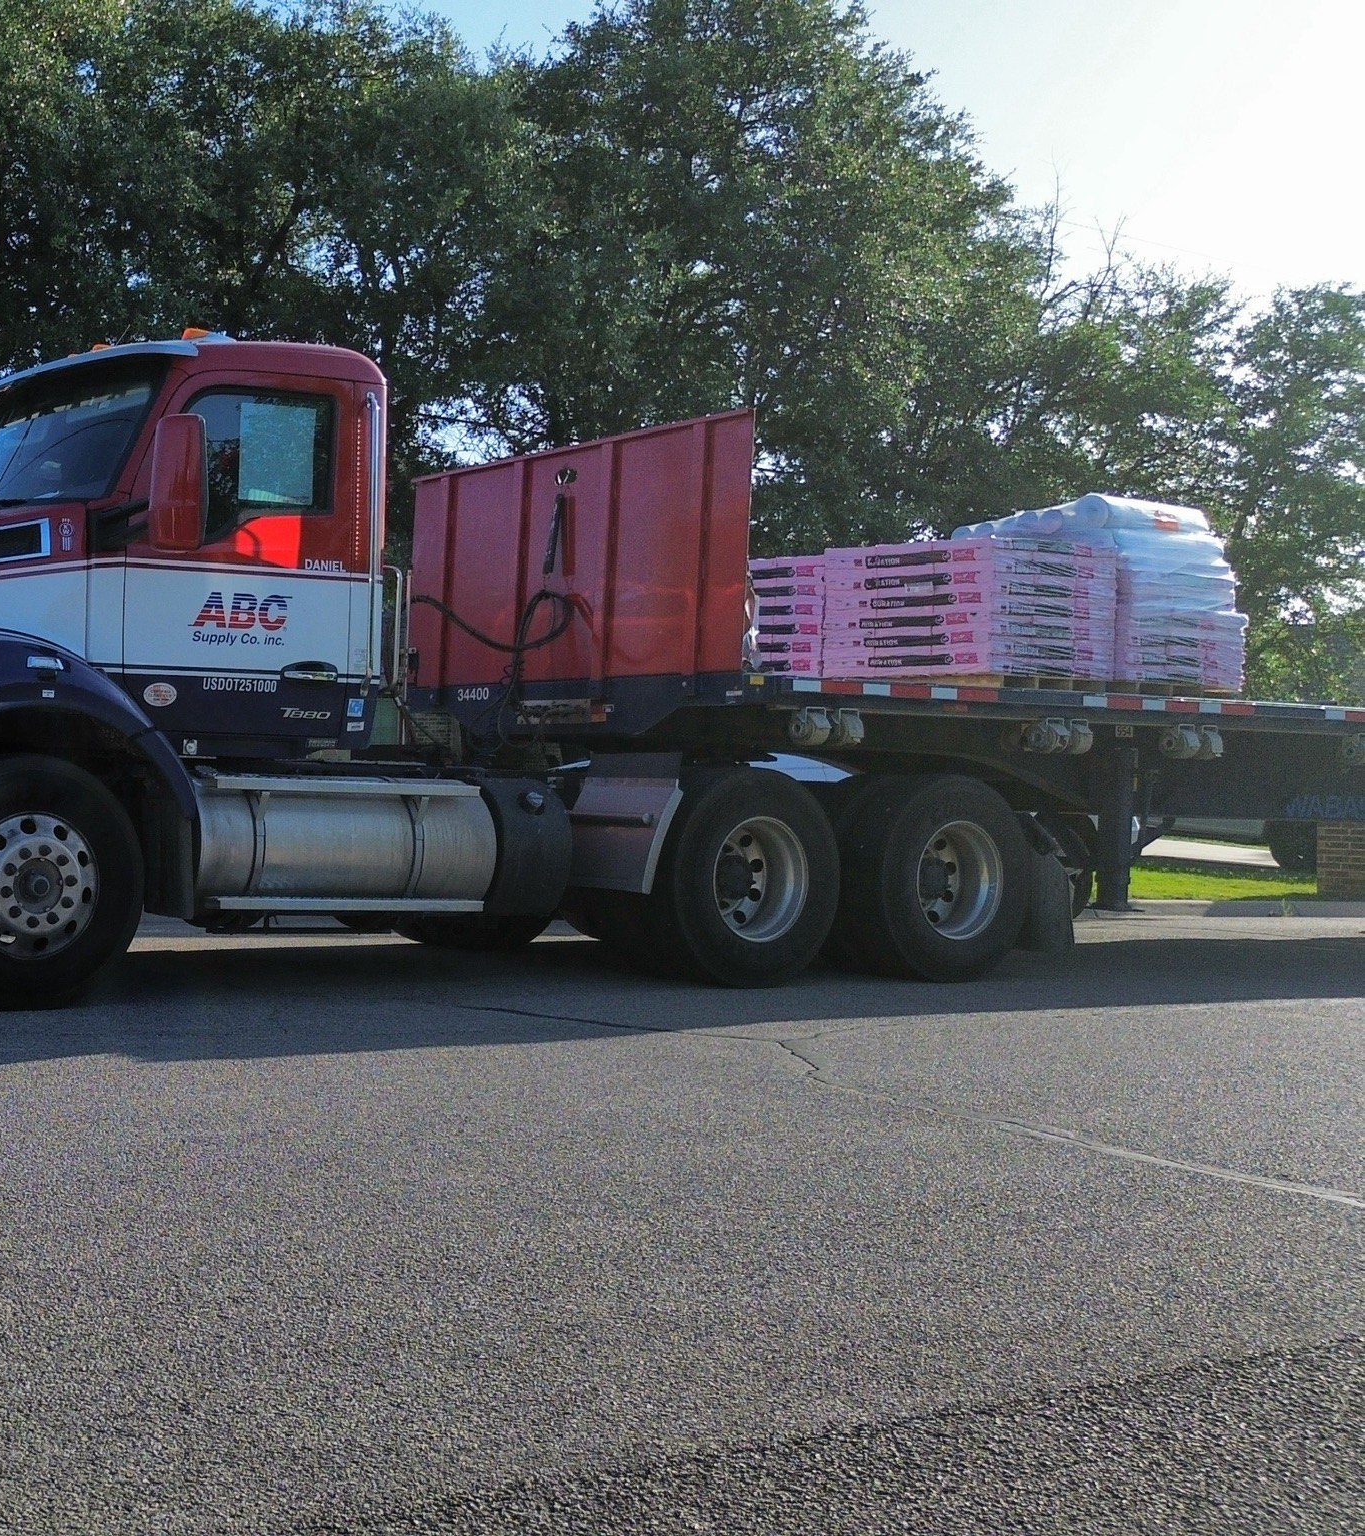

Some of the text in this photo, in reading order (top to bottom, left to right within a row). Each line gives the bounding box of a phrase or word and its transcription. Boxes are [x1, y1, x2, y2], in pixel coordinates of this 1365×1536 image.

[304, 558, 347, 573] DANIEL
[187, 592, 293, 631] ABC
[192, 630, 285, 647] Supply Co. inc.
[202, 677, 278, 693] USDOT251000
[457, 687, 490, 701] 34400
[280, 707, 331, 720] T880
